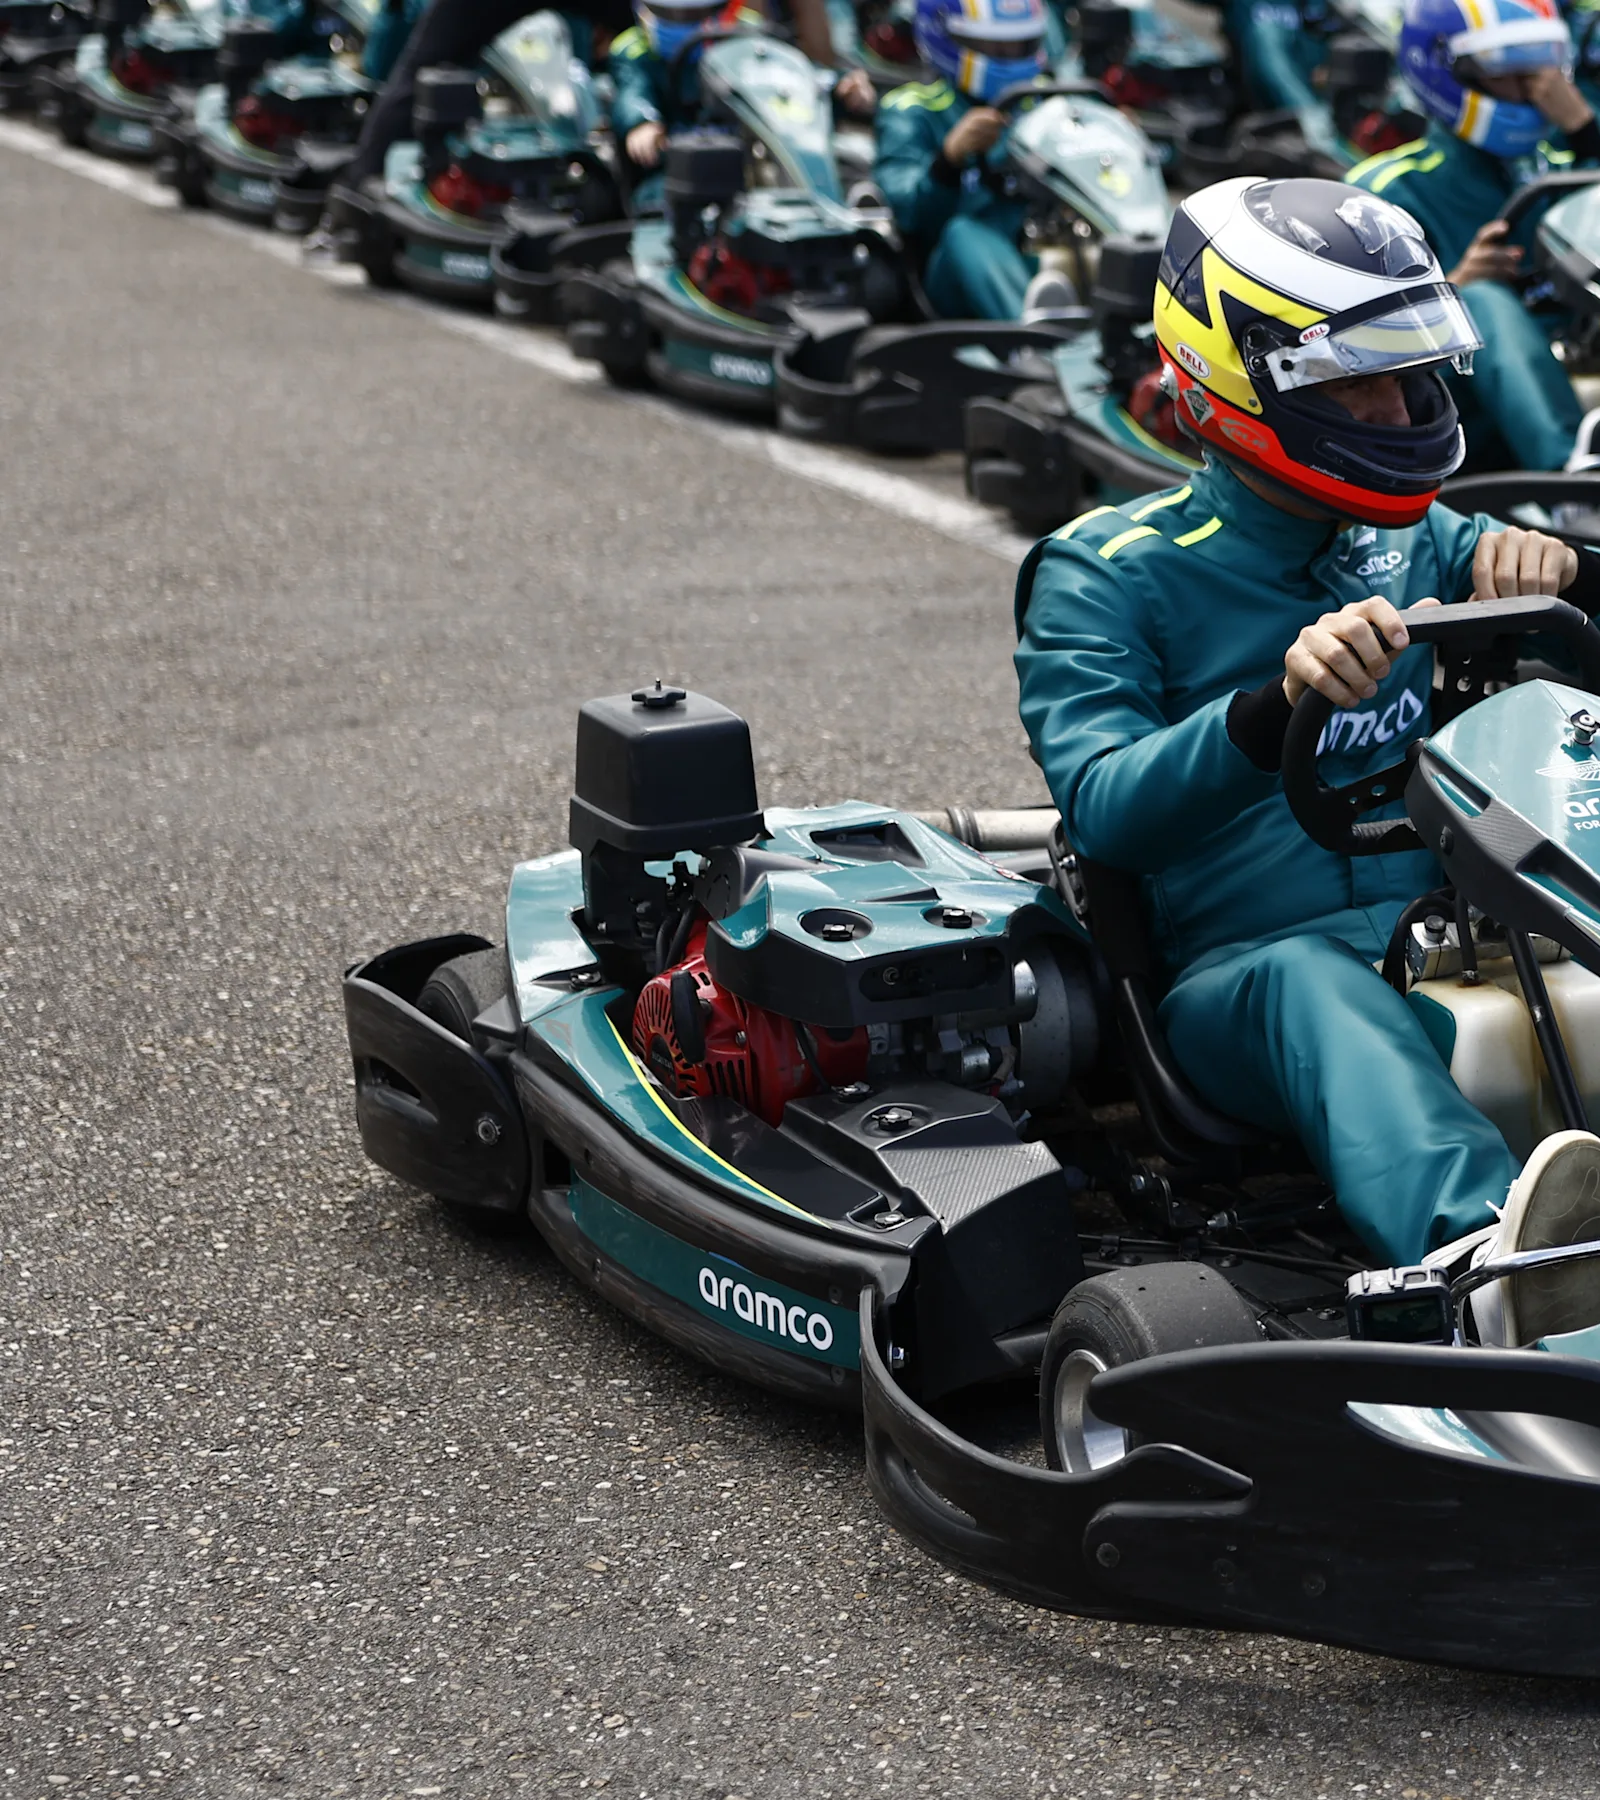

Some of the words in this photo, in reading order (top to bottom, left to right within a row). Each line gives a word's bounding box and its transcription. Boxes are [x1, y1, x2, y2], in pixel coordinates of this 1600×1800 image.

[1303, 326, 1326, 342] BELL
[1180, 346, 1204, 374] BELL
[698, 1267, 834, 1351] aramco
